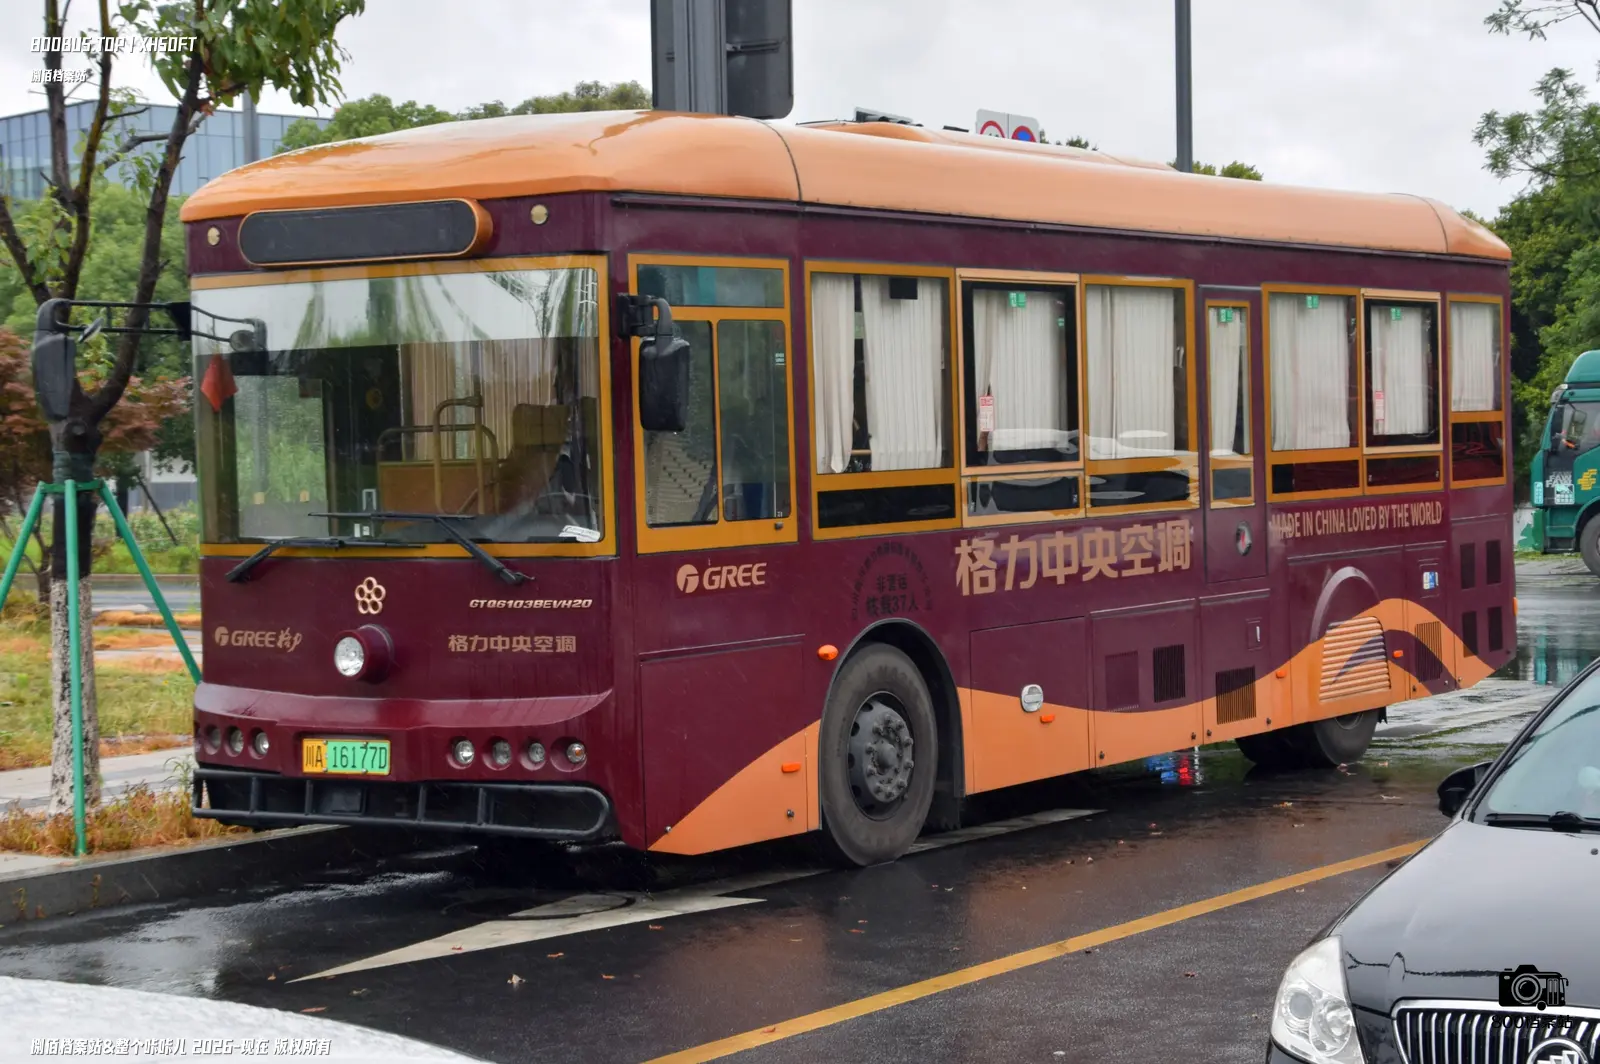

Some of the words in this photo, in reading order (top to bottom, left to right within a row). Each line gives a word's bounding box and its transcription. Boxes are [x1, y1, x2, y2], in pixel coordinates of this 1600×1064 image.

[1271, 512, 1301, 540] MADE
[1302, 511, 1314, 537] IN
[1314, 508, 1346, 536] CHINA
[1347, 505, 1377, 533] LOVED
[1378, 506, 1391, 530] BY
[1391, 503, 1410, 528] THE
[1410, 501, 1443, 526] WORLD
[954, 519, 1191, 597] 格力中央空调
[703, 562, 767, 590] GREE
[231, 630, 277, 648] GREE
[448, 634, 577, 653] 格力中央空调
